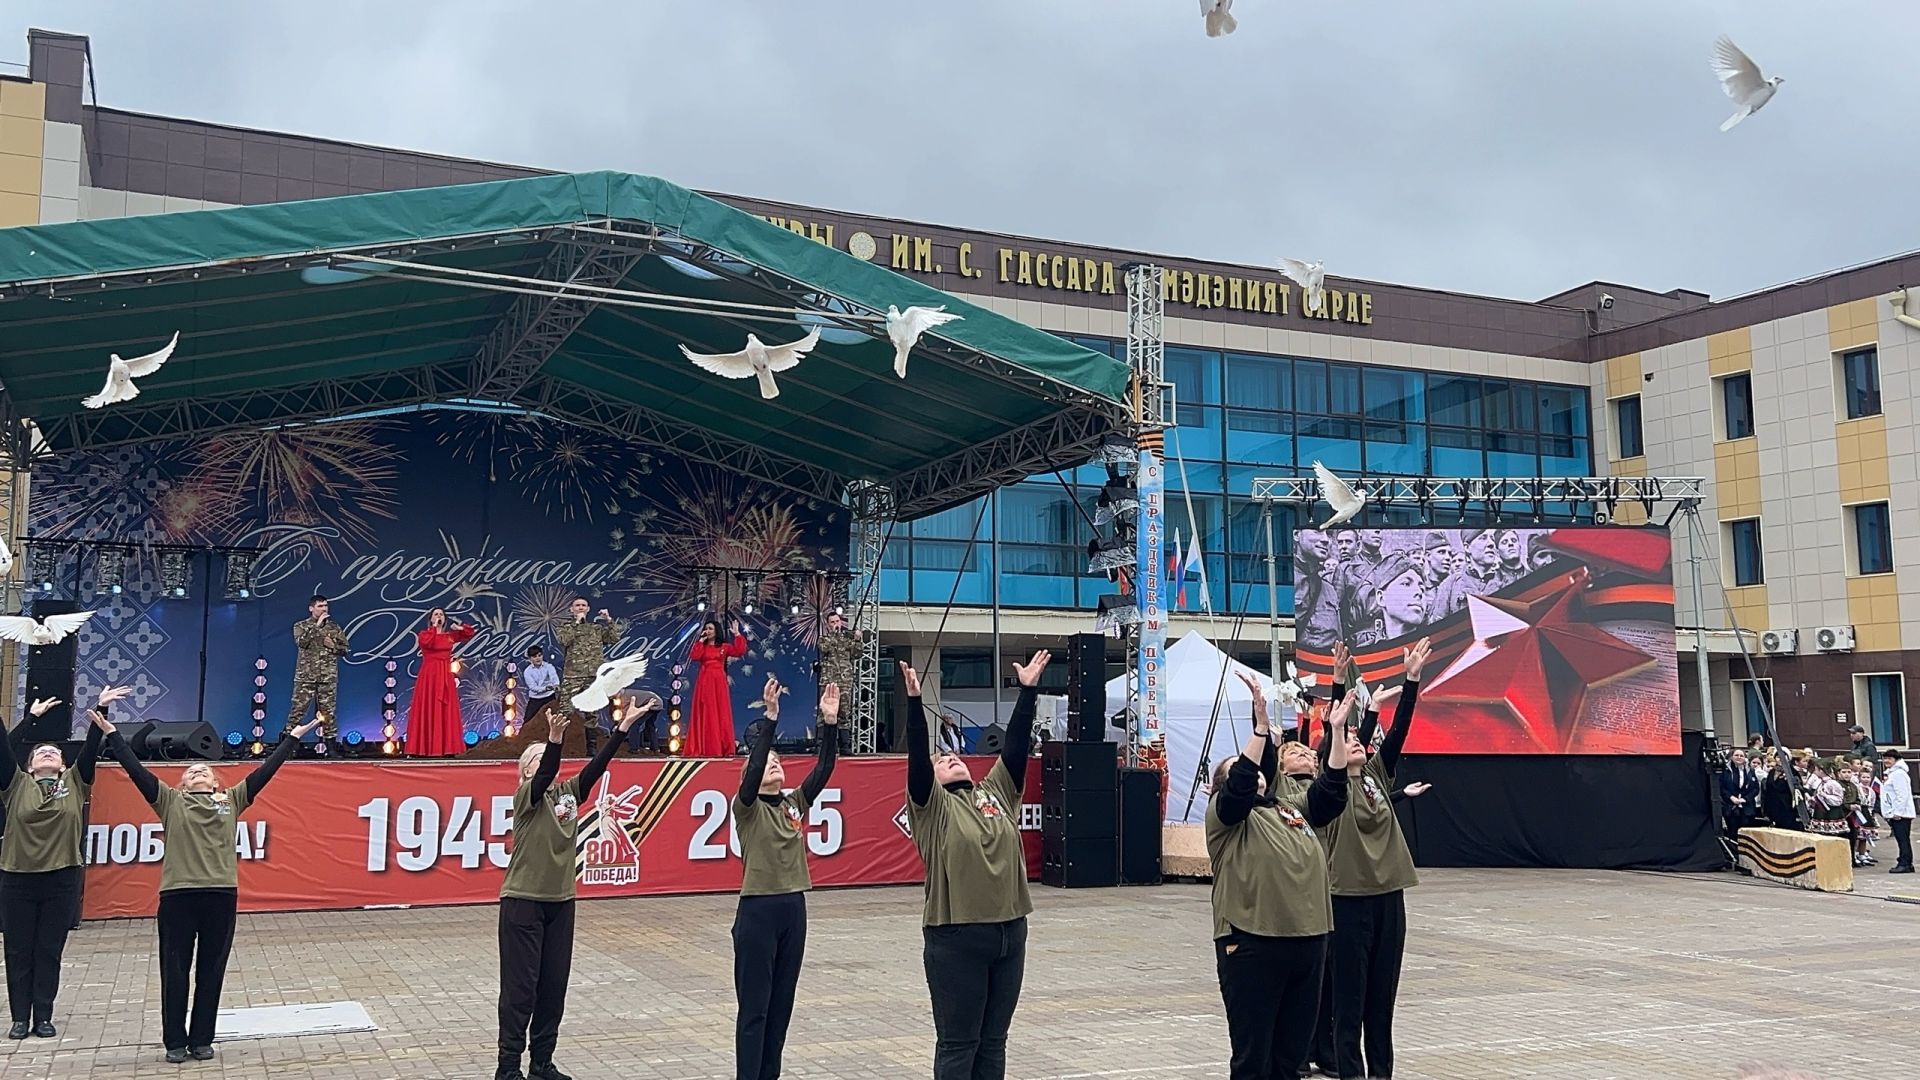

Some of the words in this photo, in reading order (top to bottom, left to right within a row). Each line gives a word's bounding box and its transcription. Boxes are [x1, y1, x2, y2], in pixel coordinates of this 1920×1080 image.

[892, 234, 942, 273] ИМ.
[959, 242, 983, 278] С.
[1000, 248, 1116, 294] ГАССАРА
[1148, 466, 1157, 477] С
[314, 549, 639, 602] праздником!
[1147, 494, 1159, 630] ПРАЗДНИКОМ
[1145, 647, 1159, 730] ПОБЕДЫ
[86, 821, 267, 864] ПОБА!
[358, 796, 513, 872] 1945
[688, 788, 843, 860] 25
[585, 867, 637, 883] ПОБЕДА!
[586, 840, 614, 865] 80
